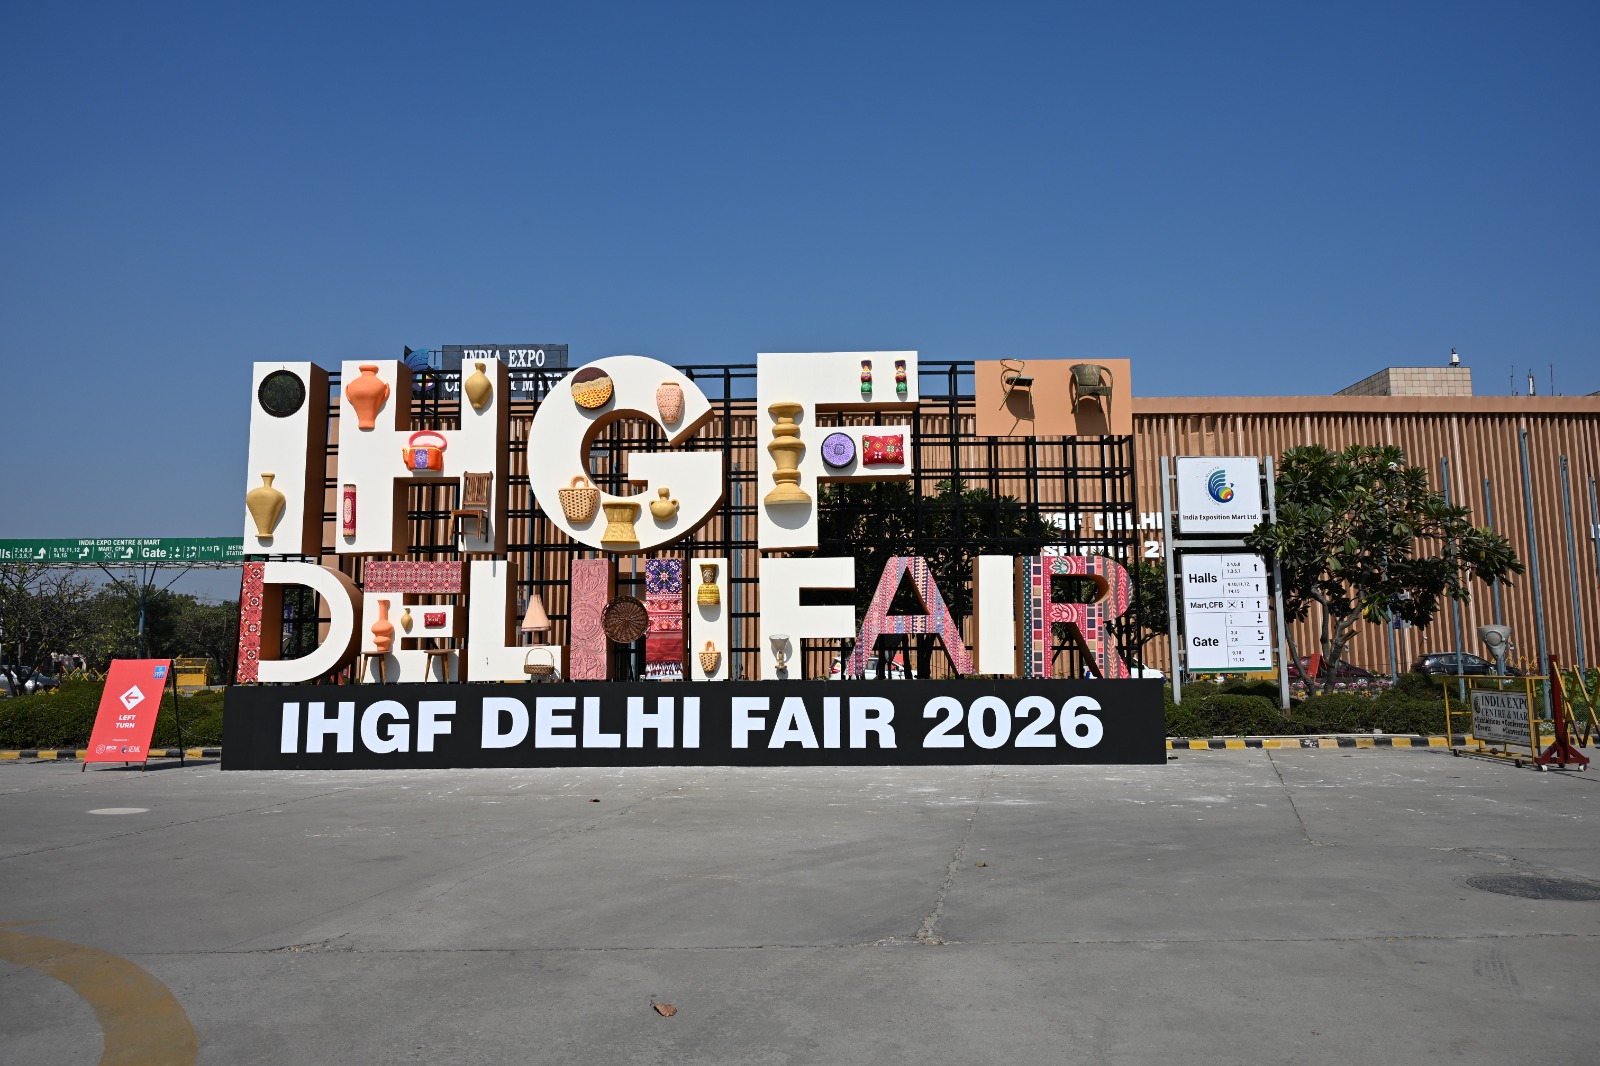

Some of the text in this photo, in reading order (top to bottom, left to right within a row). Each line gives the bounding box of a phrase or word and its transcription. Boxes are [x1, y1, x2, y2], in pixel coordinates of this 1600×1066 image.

[508, 350, 546, 368] EXPO
[142, 547, 166, 558] Gate
[1189, 573, 1218, 583] Halls
[759, 556, 1134, 682] FAIR
[1193, 637, 1219, 647] Gate
[1482, 696, 1505, 708] INDIA
[1482, 708, 1506, 719] CENTRE
[280, 695, 1104, 754] IHGF DELHI FAIR 2026
